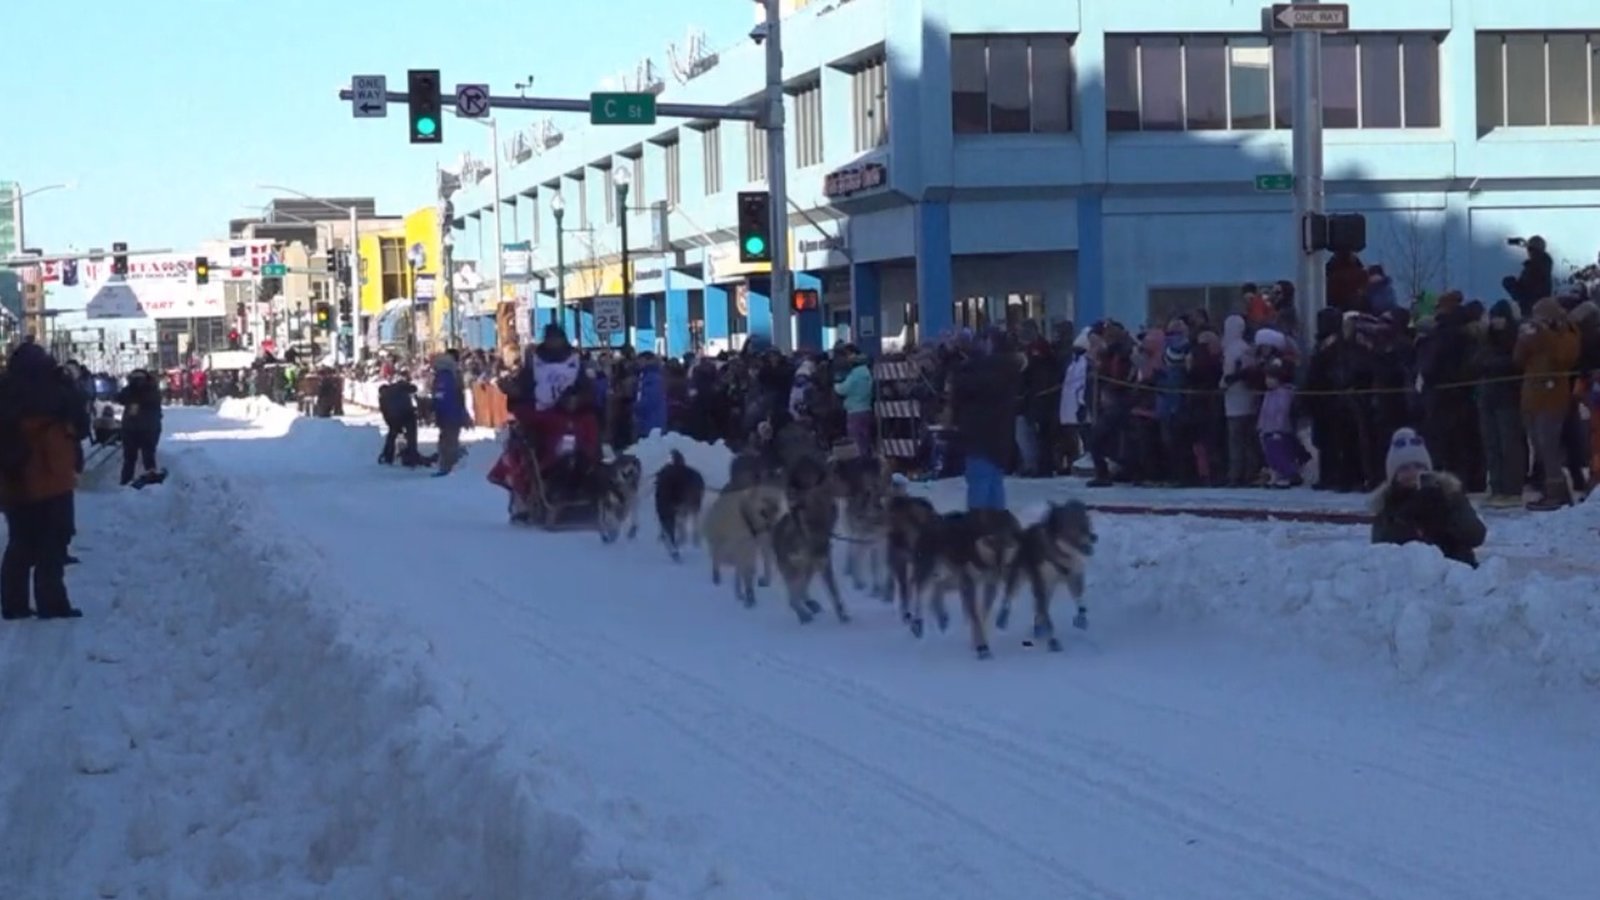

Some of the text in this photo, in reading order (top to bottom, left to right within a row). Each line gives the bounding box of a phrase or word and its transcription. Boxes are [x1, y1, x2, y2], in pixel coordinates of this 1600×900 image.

[1294, 11, 1339, 22] ONE WAY
[358, 79, 381, 89] ONE
[358, 90, 381, 99] WAY
[604, 99, 617, 118] C
[597, 315, 620, 329] 25
